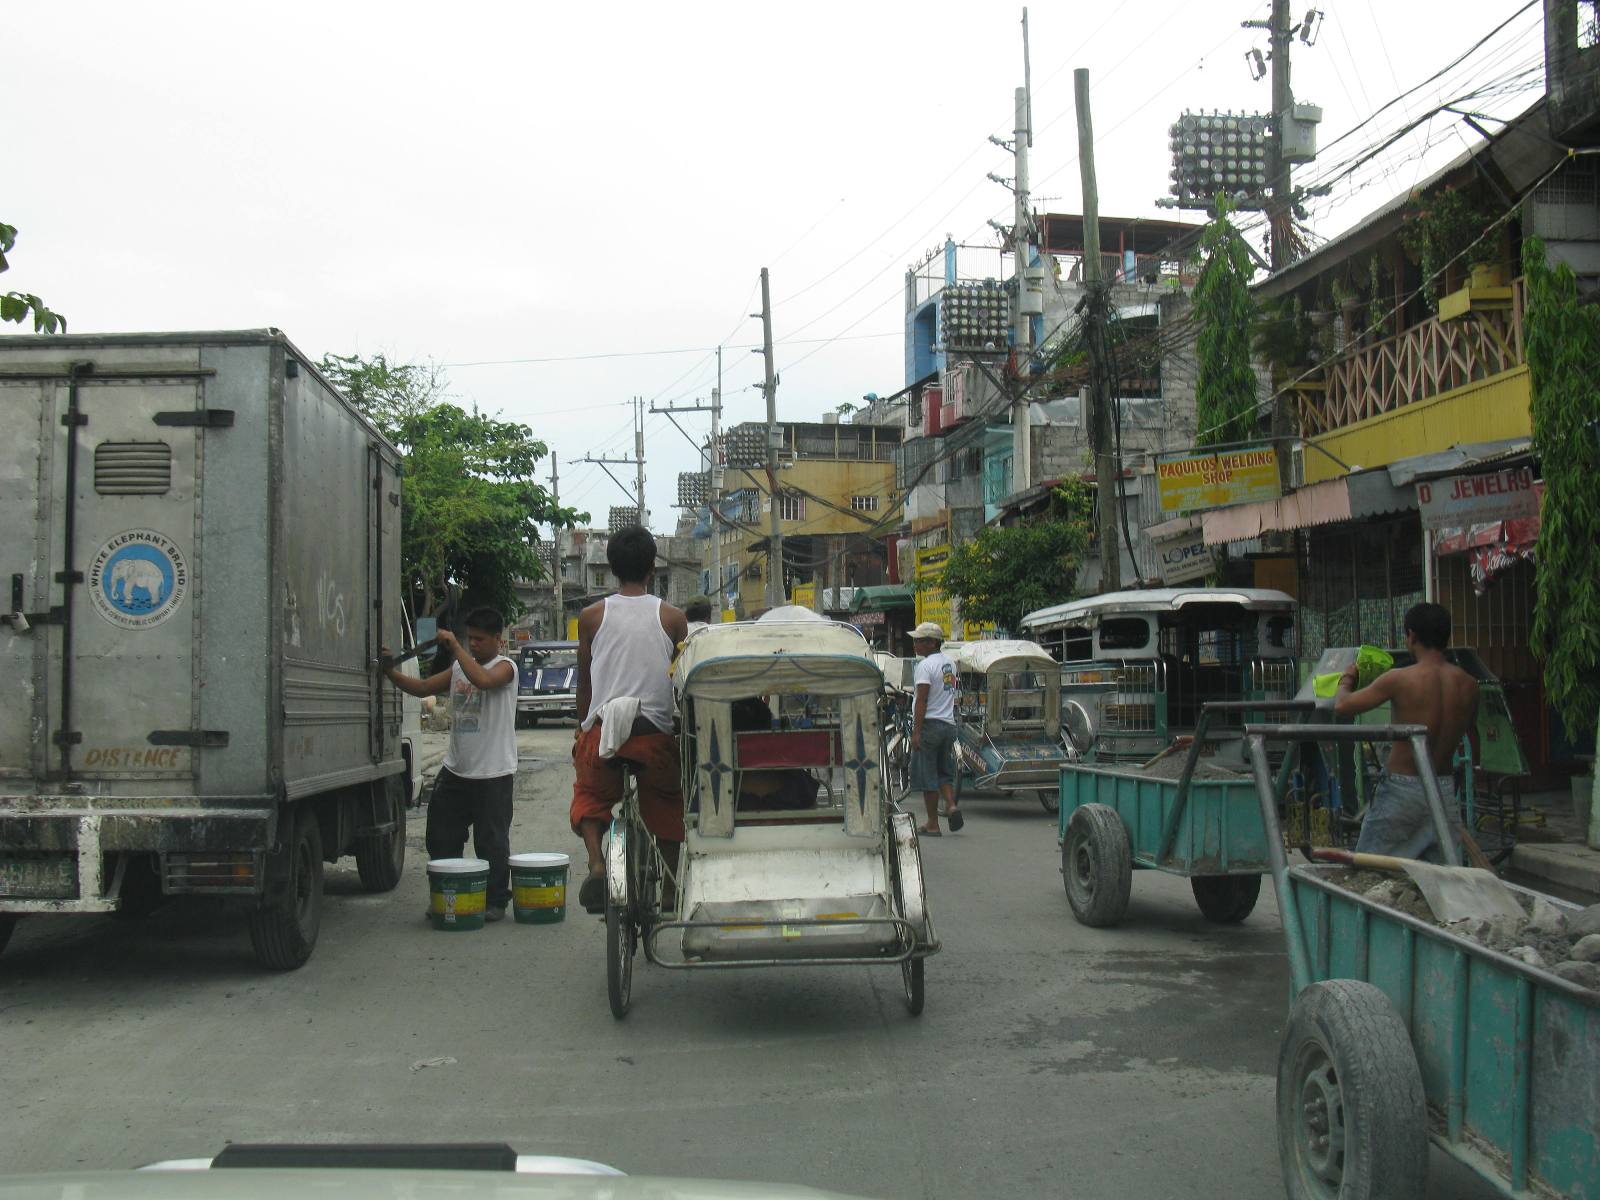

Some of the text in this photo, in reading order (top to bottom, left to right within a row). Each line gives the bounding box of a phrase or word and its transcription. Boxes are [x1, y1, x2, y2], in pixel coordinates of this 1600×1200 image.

[1159, 451, 1273, 479] PAQUITOS WELDING
[1201, 470, 1233, 485] SHOP
[1450, 470, 1532, 500] JEWELRY
[91, 533, 185, 587] WHITE ELEPHANT BRAND
[1162, 543, 1207, 564] LOPEZ
